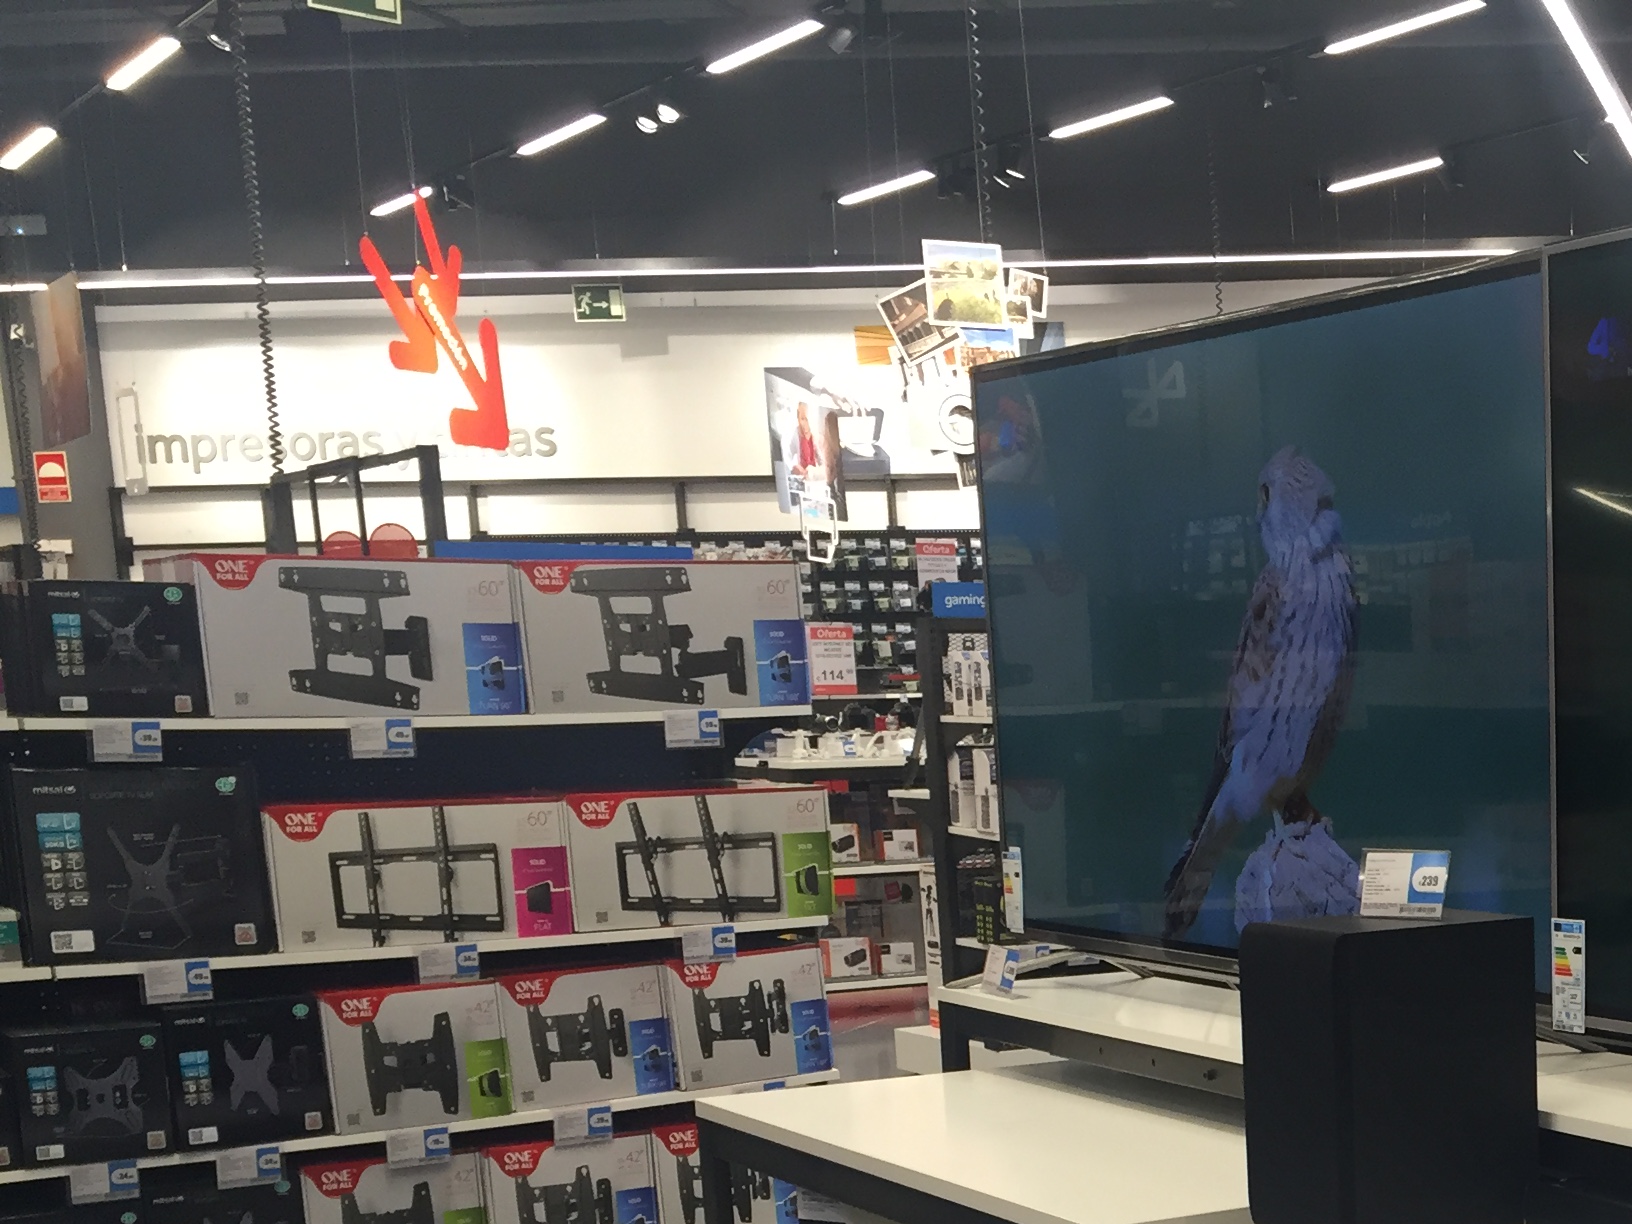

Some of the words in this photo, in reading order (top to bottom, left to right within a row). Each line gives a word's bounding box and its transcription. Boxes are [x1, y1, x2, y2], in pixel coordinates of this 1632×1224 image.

[922, 544, 950, 554] Oferta
[215, 559, 249, 573] ONE
[533, 565, 562, 578] ONE
[216, 573, 232, 581] FOR
[232, 572, 250, 581] ALL
[551, 578, 564, 586] ALL
[816, 629, 847, 638] Oferta
[580, 800, 610, 813] ONE
[284, 811, 317, 826] ONE
[598, 812, 610, 820] ALL
[286, 825, 302, 833] FOR
[302, 825, 318, 833] ALL
[684, 963, 712, 976] ONE
[700, 973, 712, 981] ALL
[514, 980, 545, 993] ONE
[341, 998, 372, 1011] ONE
[668, 1130, 696, 1143] ONE
[670, 1142, 683, 1150] FOR
[504, 1149, 533, 1164] ONE
[505, 1163, 519, 1171] FOR
[520, 1161, 533, 1169] ALL
[321, 1169, 351, 1183] ONE
[322, 1183, 339, 1191] FOR
[339, 1181, 353, 1189] ALL
